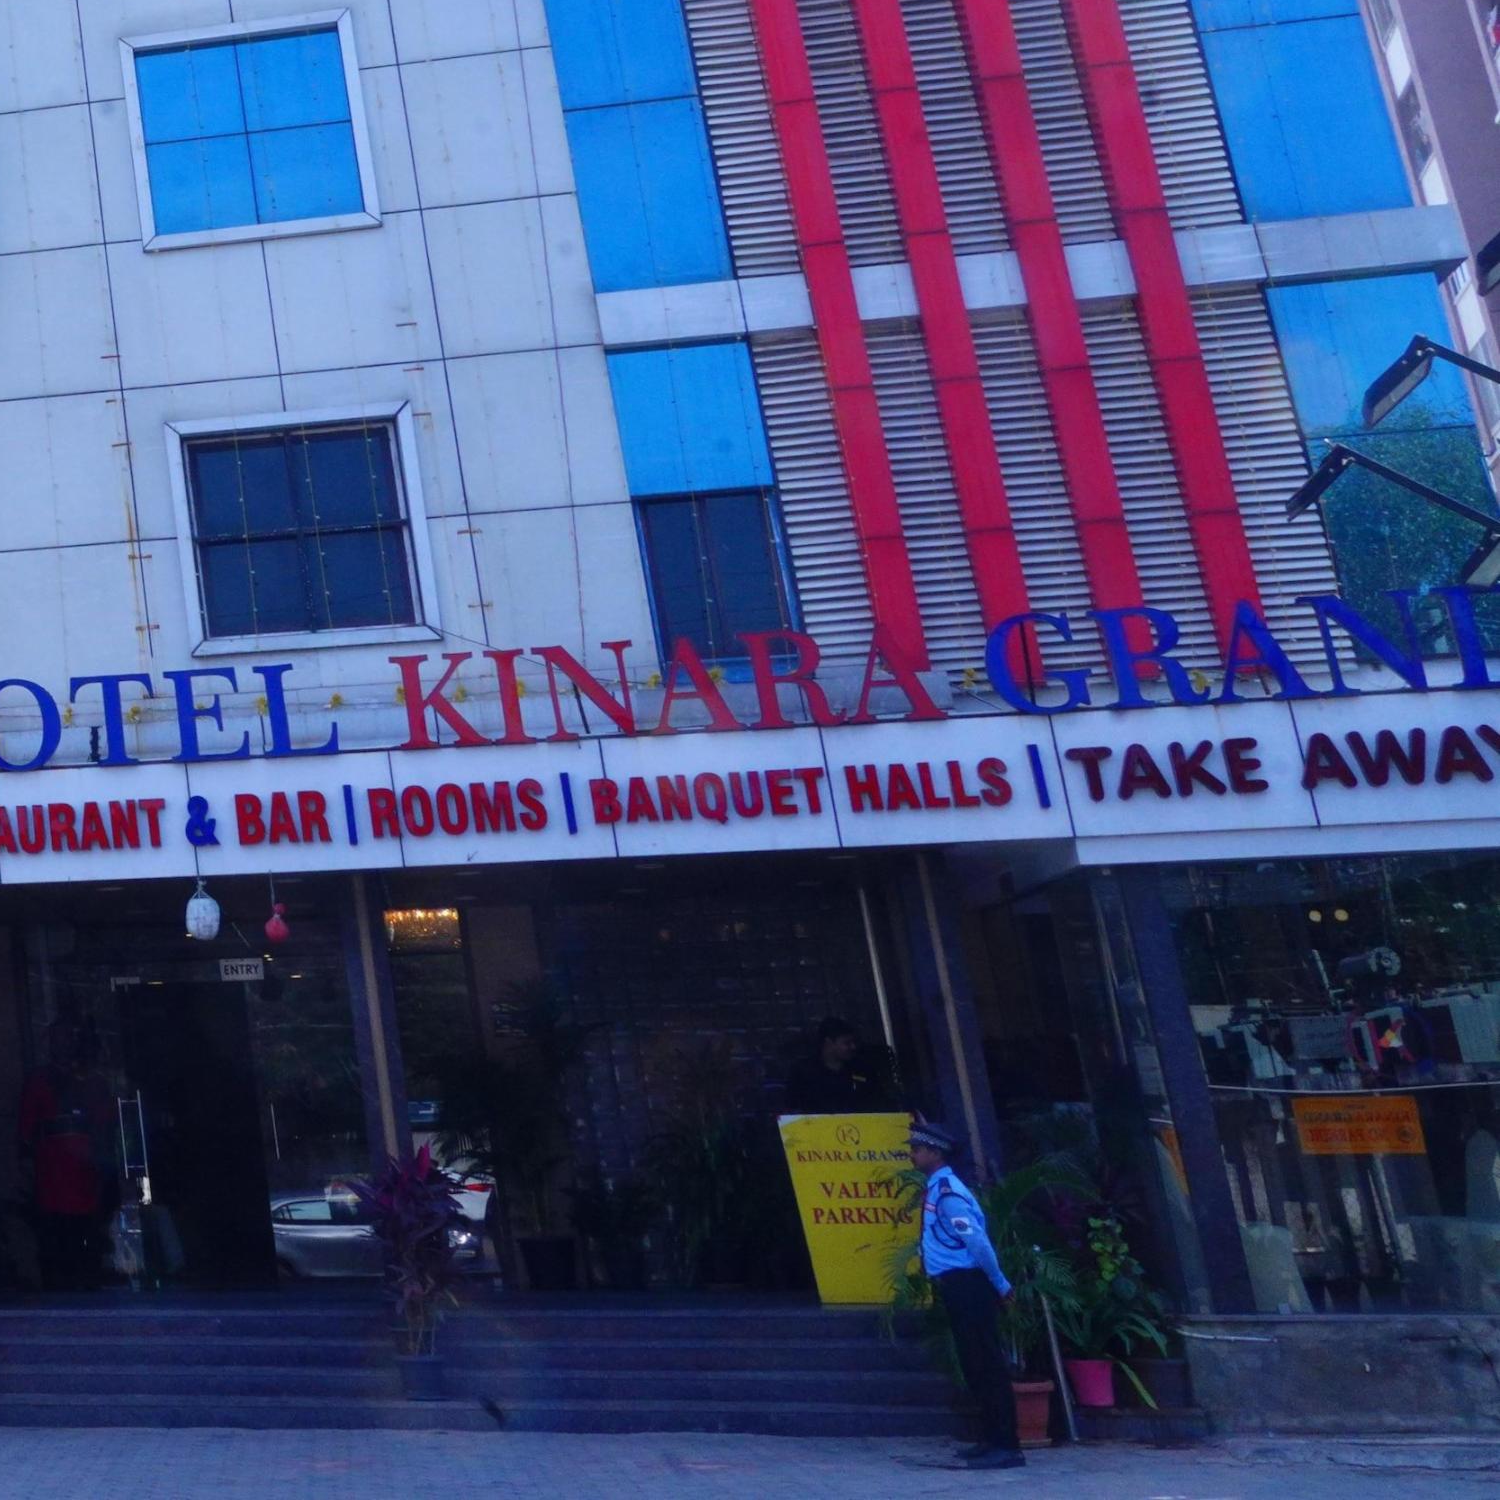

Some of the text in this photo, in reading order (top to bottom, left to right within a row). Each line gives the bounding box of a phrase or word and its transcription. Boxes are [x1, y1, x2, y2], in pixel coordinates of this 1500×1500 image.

[388, 625, 949, 751] KINARA
[184, 795, 221, 848] &
[233, 790, 332, 845] BAR
[366, 777, 549, 840] ROOMS
[591, 765, 826, 826] BANQUET
[843, 756, 1013, 815] HALLS
[1064, 735, 1269, 803] TAKE
[223, 962, 260, 977] ENTRY
[796, 1150, 911, 1163] KINARA GRAND
[820, 1182, 895, 1199] VALET
[813, 1207, 913, 1225] PARKING
